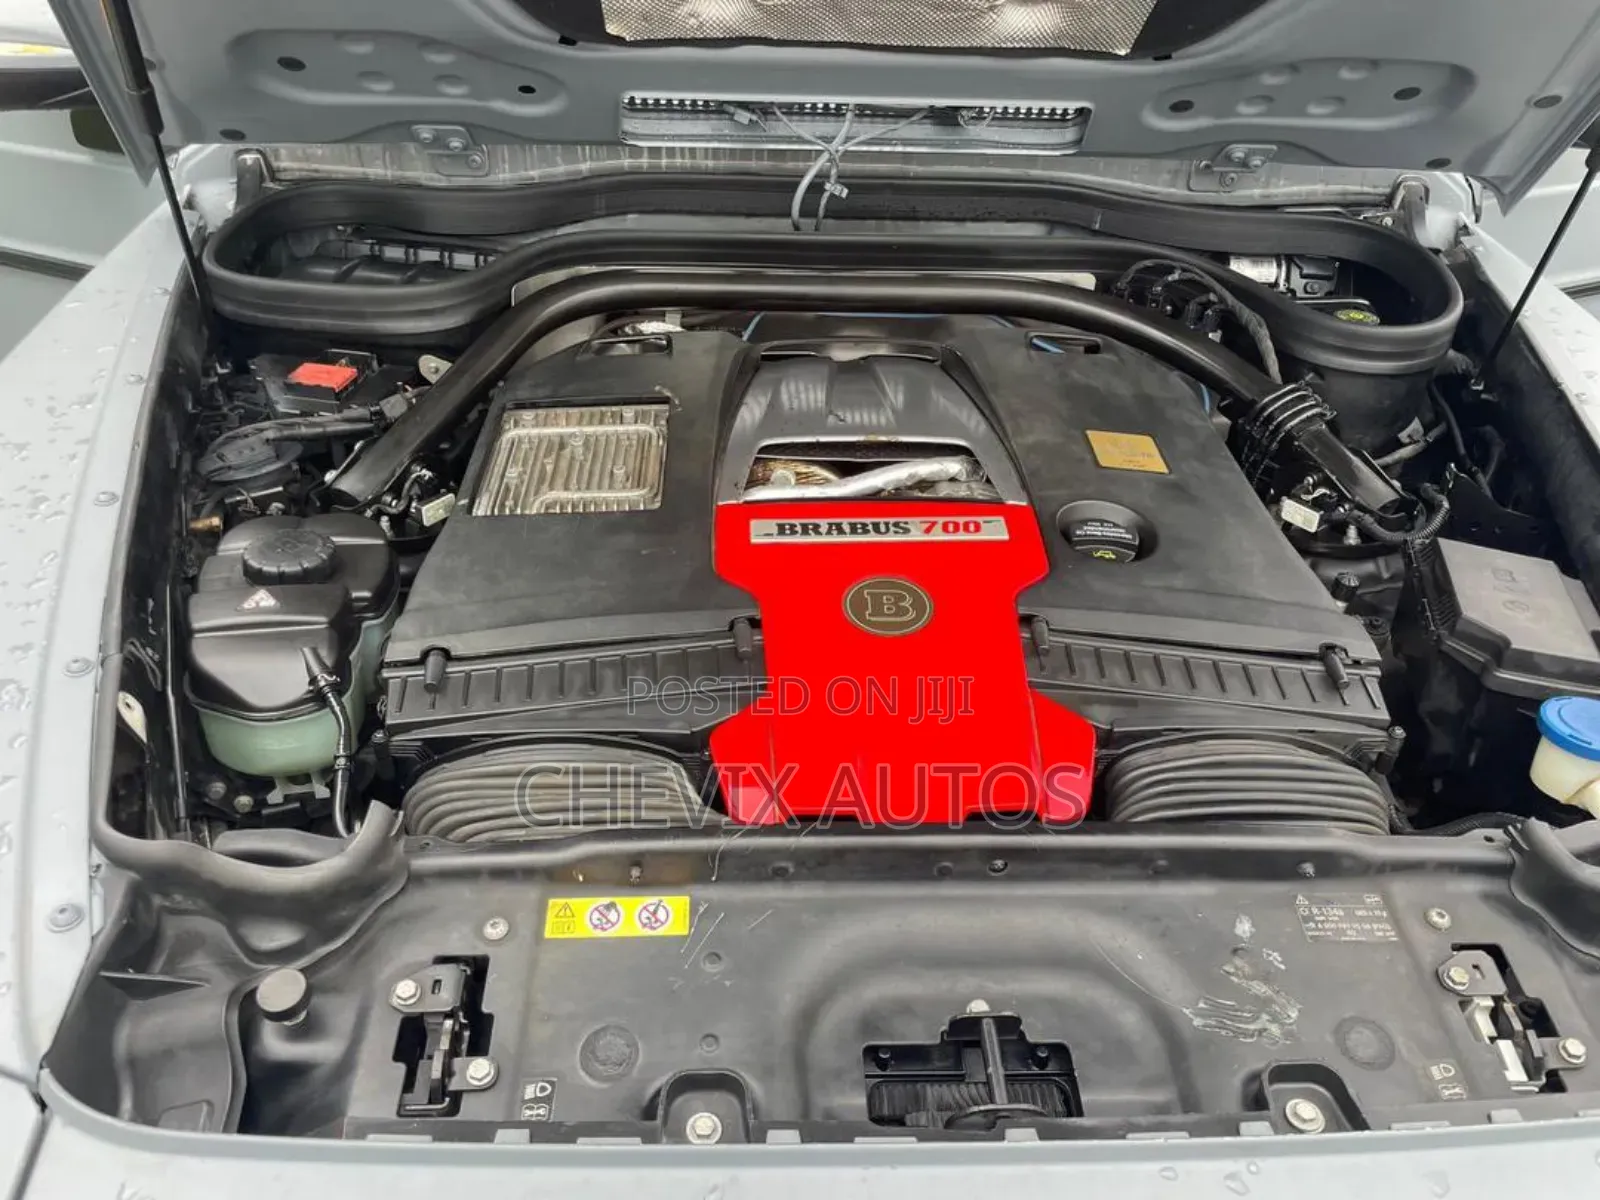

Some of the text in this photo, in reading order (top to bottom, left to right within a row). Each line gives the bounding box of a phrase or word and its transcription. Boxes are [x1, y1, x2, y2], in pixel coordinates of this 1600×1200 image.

[776, 521, 982, 536] BRABUS 700
[864, 589, 916, 621] B
